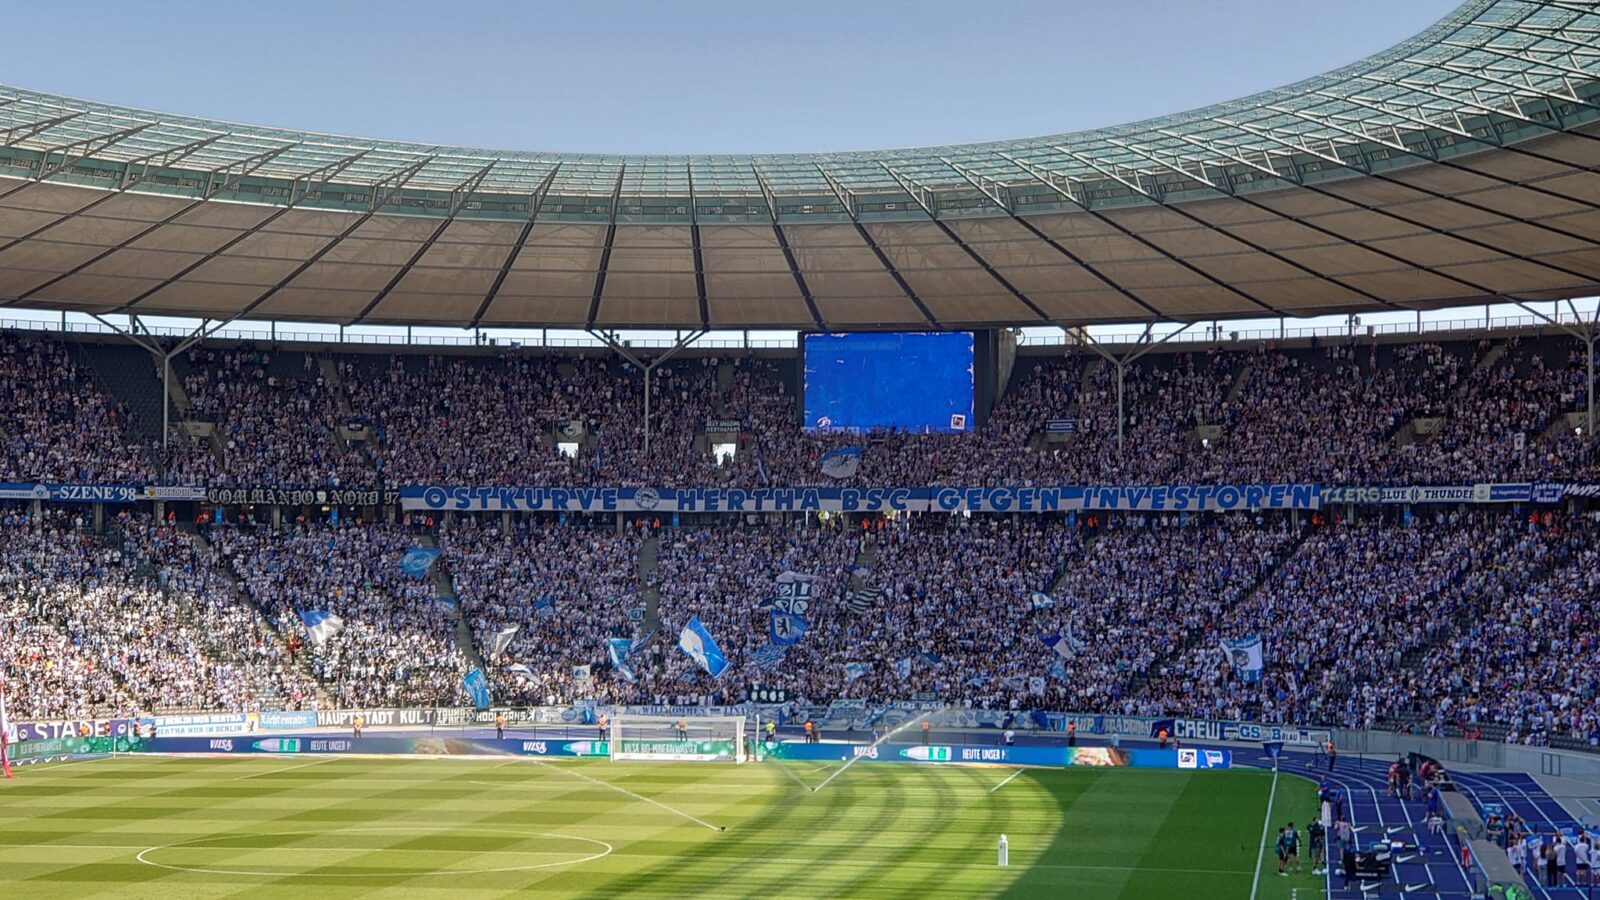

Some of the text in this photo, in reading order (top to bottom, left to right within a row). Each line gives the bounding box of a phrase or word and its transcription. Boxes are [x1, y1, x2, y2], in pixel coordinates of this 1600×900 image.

[208, 489, 399, 505] COMMANDO NORD 97
[424, 486, 619, 510] OSTKURVE
[676, 488, 821, 511] HERTHA
[841, 488, 911, 511] BSC
[937, 487, 1061, 511] GEGEN
[1083, 485, 1315, 510] INVESTOREN
[1380, 490, 1407, 500] BLUE
[318, 710, 432, 725] HAUPTSTADT KULT
[476, 711, 526, 722] HOOLGANS
[1174, 720, 1220, 739] CREW
[1239, 725, 1262, 739] GS
[962, 748, 981, 760] HEUTE
[981, 749, 1001, 760] UNSER
